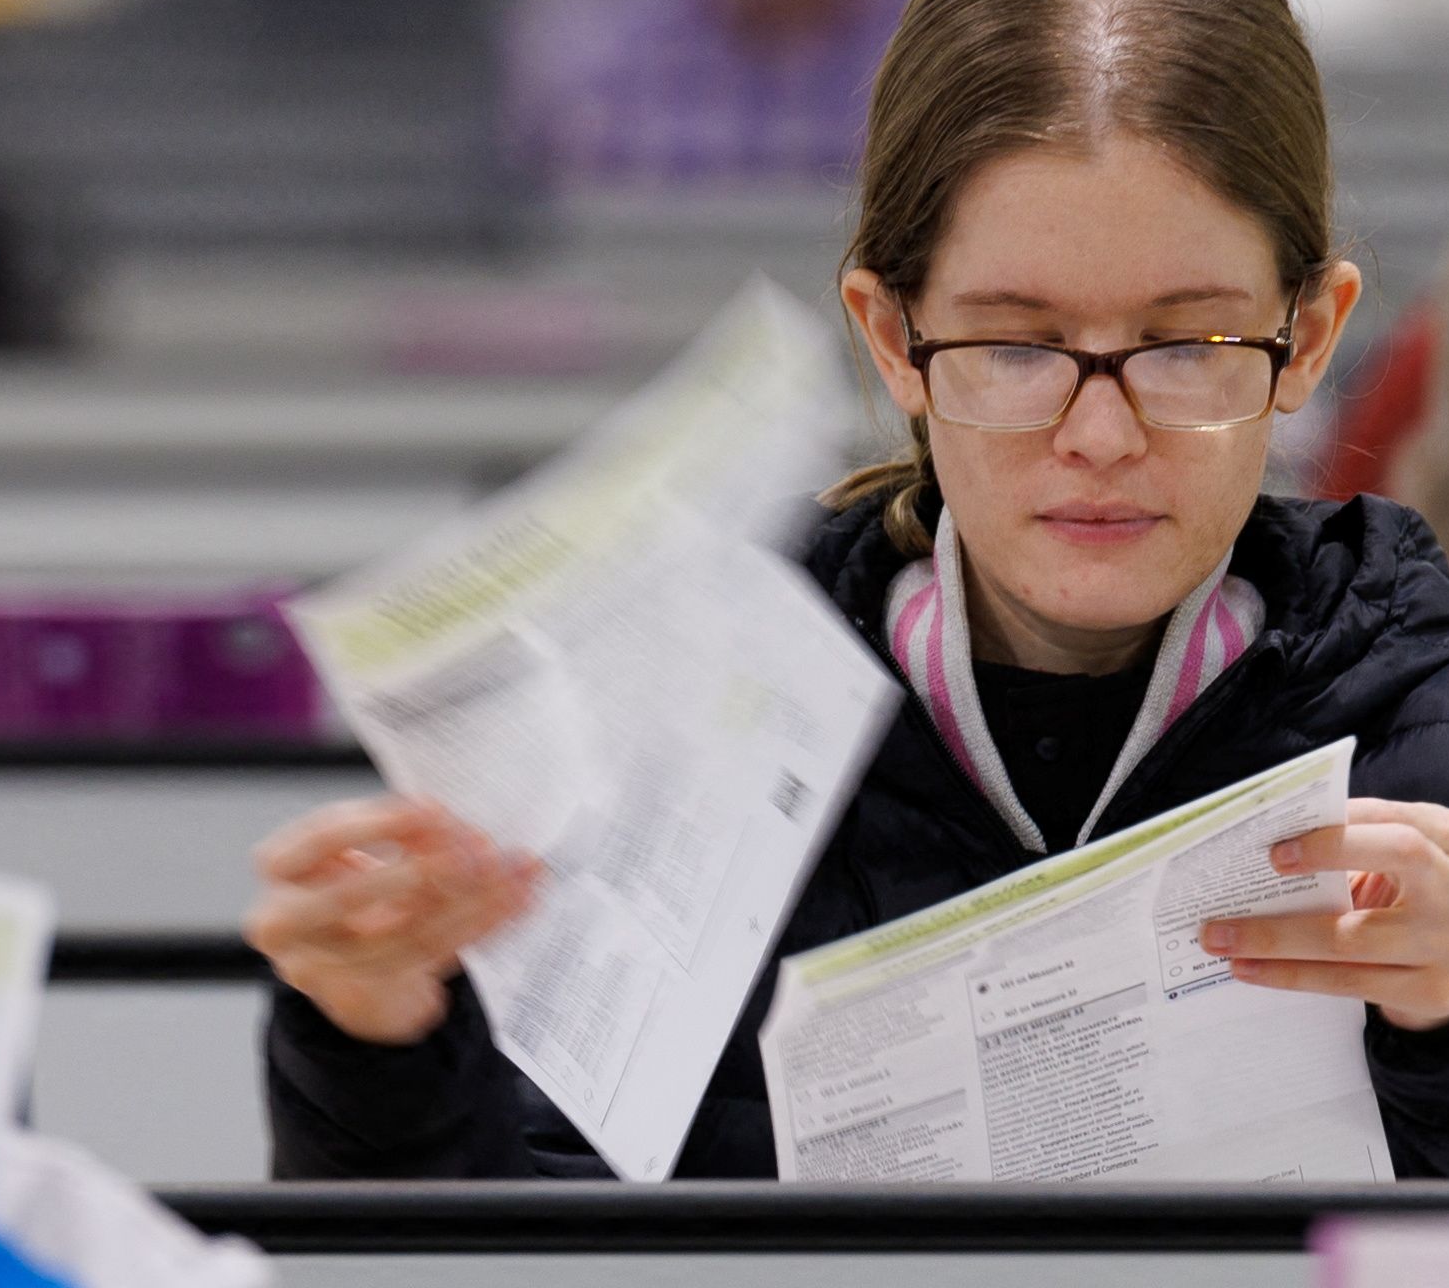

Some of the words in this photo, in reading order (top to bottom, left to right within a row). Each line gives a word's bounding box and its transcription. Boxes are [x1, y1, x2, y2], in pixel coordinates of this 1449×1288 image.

[1263, 890, 1281, 900] AIDS
[1193, 963, 1205, 971] NO
[1060, 1170, 1092, 1184] Chamber
[1093, 1167, 1101, 1175] of
[1101, 1157, 1138, 1174] Commerce
